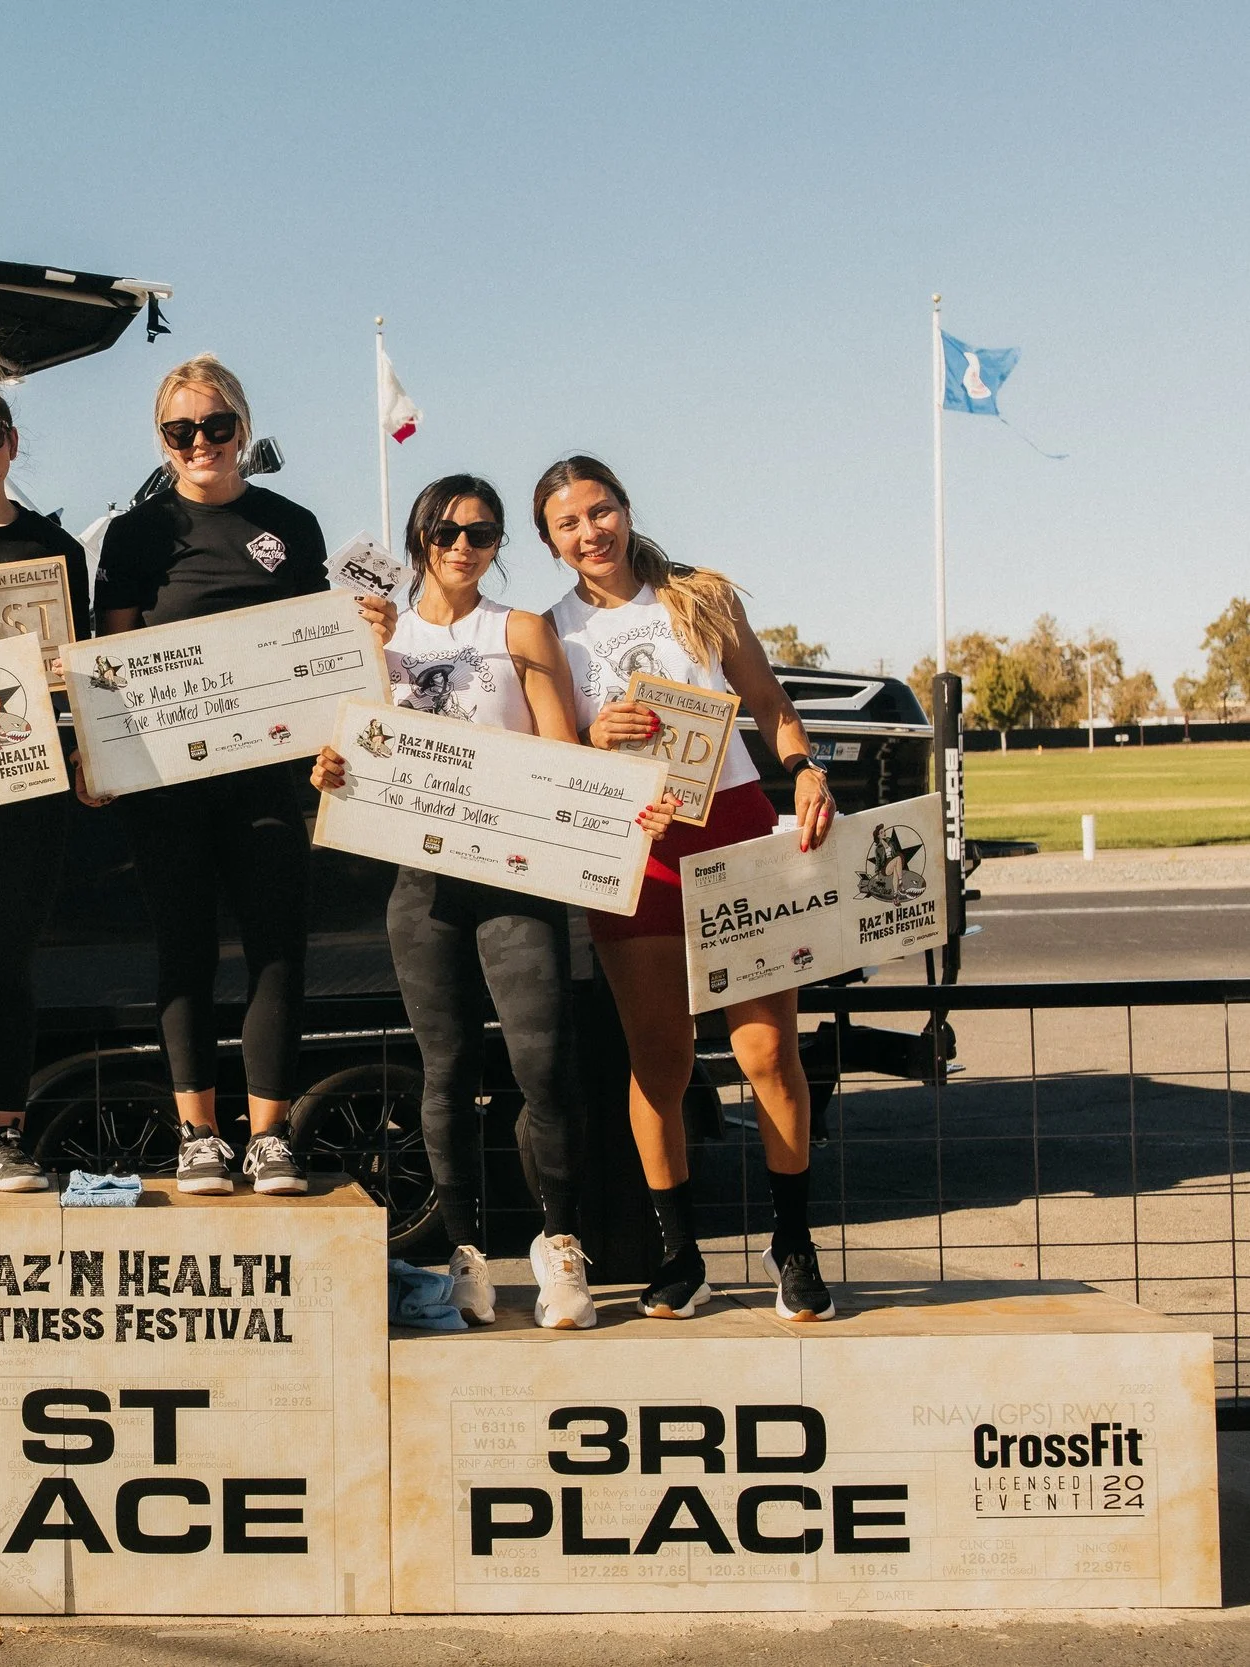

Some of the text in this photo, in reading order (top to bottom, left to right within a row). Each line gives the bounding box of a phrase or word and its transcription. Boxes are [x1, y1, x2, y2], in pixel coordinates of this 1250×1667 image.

[10, 568, 58, 584] HEALTH
[344, 560, 395, 597] RPM
[257, 640, 278, 649] DATE
[128, 645, 202, 669] RAZ'N HEALTH
[130, 656, 204, 679] FITNESS FESTIVAL
[293, 664, 309, 678] $
[124, 671, 234, 709] She Made Me Do It
[637, 684, 727, 717] RAZ'N HEALTH
[123, 697, 240, 734] Five Hundred Dollars
[397, 745, 473, 769] FITNESS FESTIVAL
[399, 733, 476, 760] RAZ'N HEALTH
[0, 759, 50, 780] FESTIVAL
[531, 774, 553, 783] DATE
[391, 767, 472, 797] Las Carnalas
[569, 777, 625, 800] 09/14/2024
[377, 786, 500, 826] Two Hundred Dollars
[945, 748, 960, 861] BOATS
[555, 810, 572, 824] $
[582, 870, 620, 887] CrossFit
[694, 862, 726, 878] CrossFit
[701, 898, 749, 923] LAS
[702, 890, 839, 939] CARNALAS
[859, 900, 936, 933] RAZ'N HEALTH
[701, 928, 765, 950] RX WOMEN
[859, 915, 936, 945] FITNESS FESTIVAL
[736, 964, 785, 982] CENTURION
[118, 1250, 292, 1298] HEALTH
[115, 1304, 293, 1343] FESTIVAL
[500, 1386, 535, 1396] TEXAS
[912, 1402, 1156, 1428] RNAV (GPS) 13
[481, 1421, 526, 1433] 63116
[474, 1439, 517, 1450] W13A
[548, 1405, 827, 1475] 3RD
[974, 1422, 1144, 1469] CrossFit
[975, 1474, 1145, 1491] LICENSED 20
[975, 1493, 1145, 1511] EVENT 24
[470, 1484, 911, 1556] PLACE
[483, 1565, 687, 1578] 118.825 127.225 317.65
[706, 1564, 746, 1577] 120.3
[850, 1564, 898, 1576] 119.45
[876, 1591, 915, 1601] DARTE
